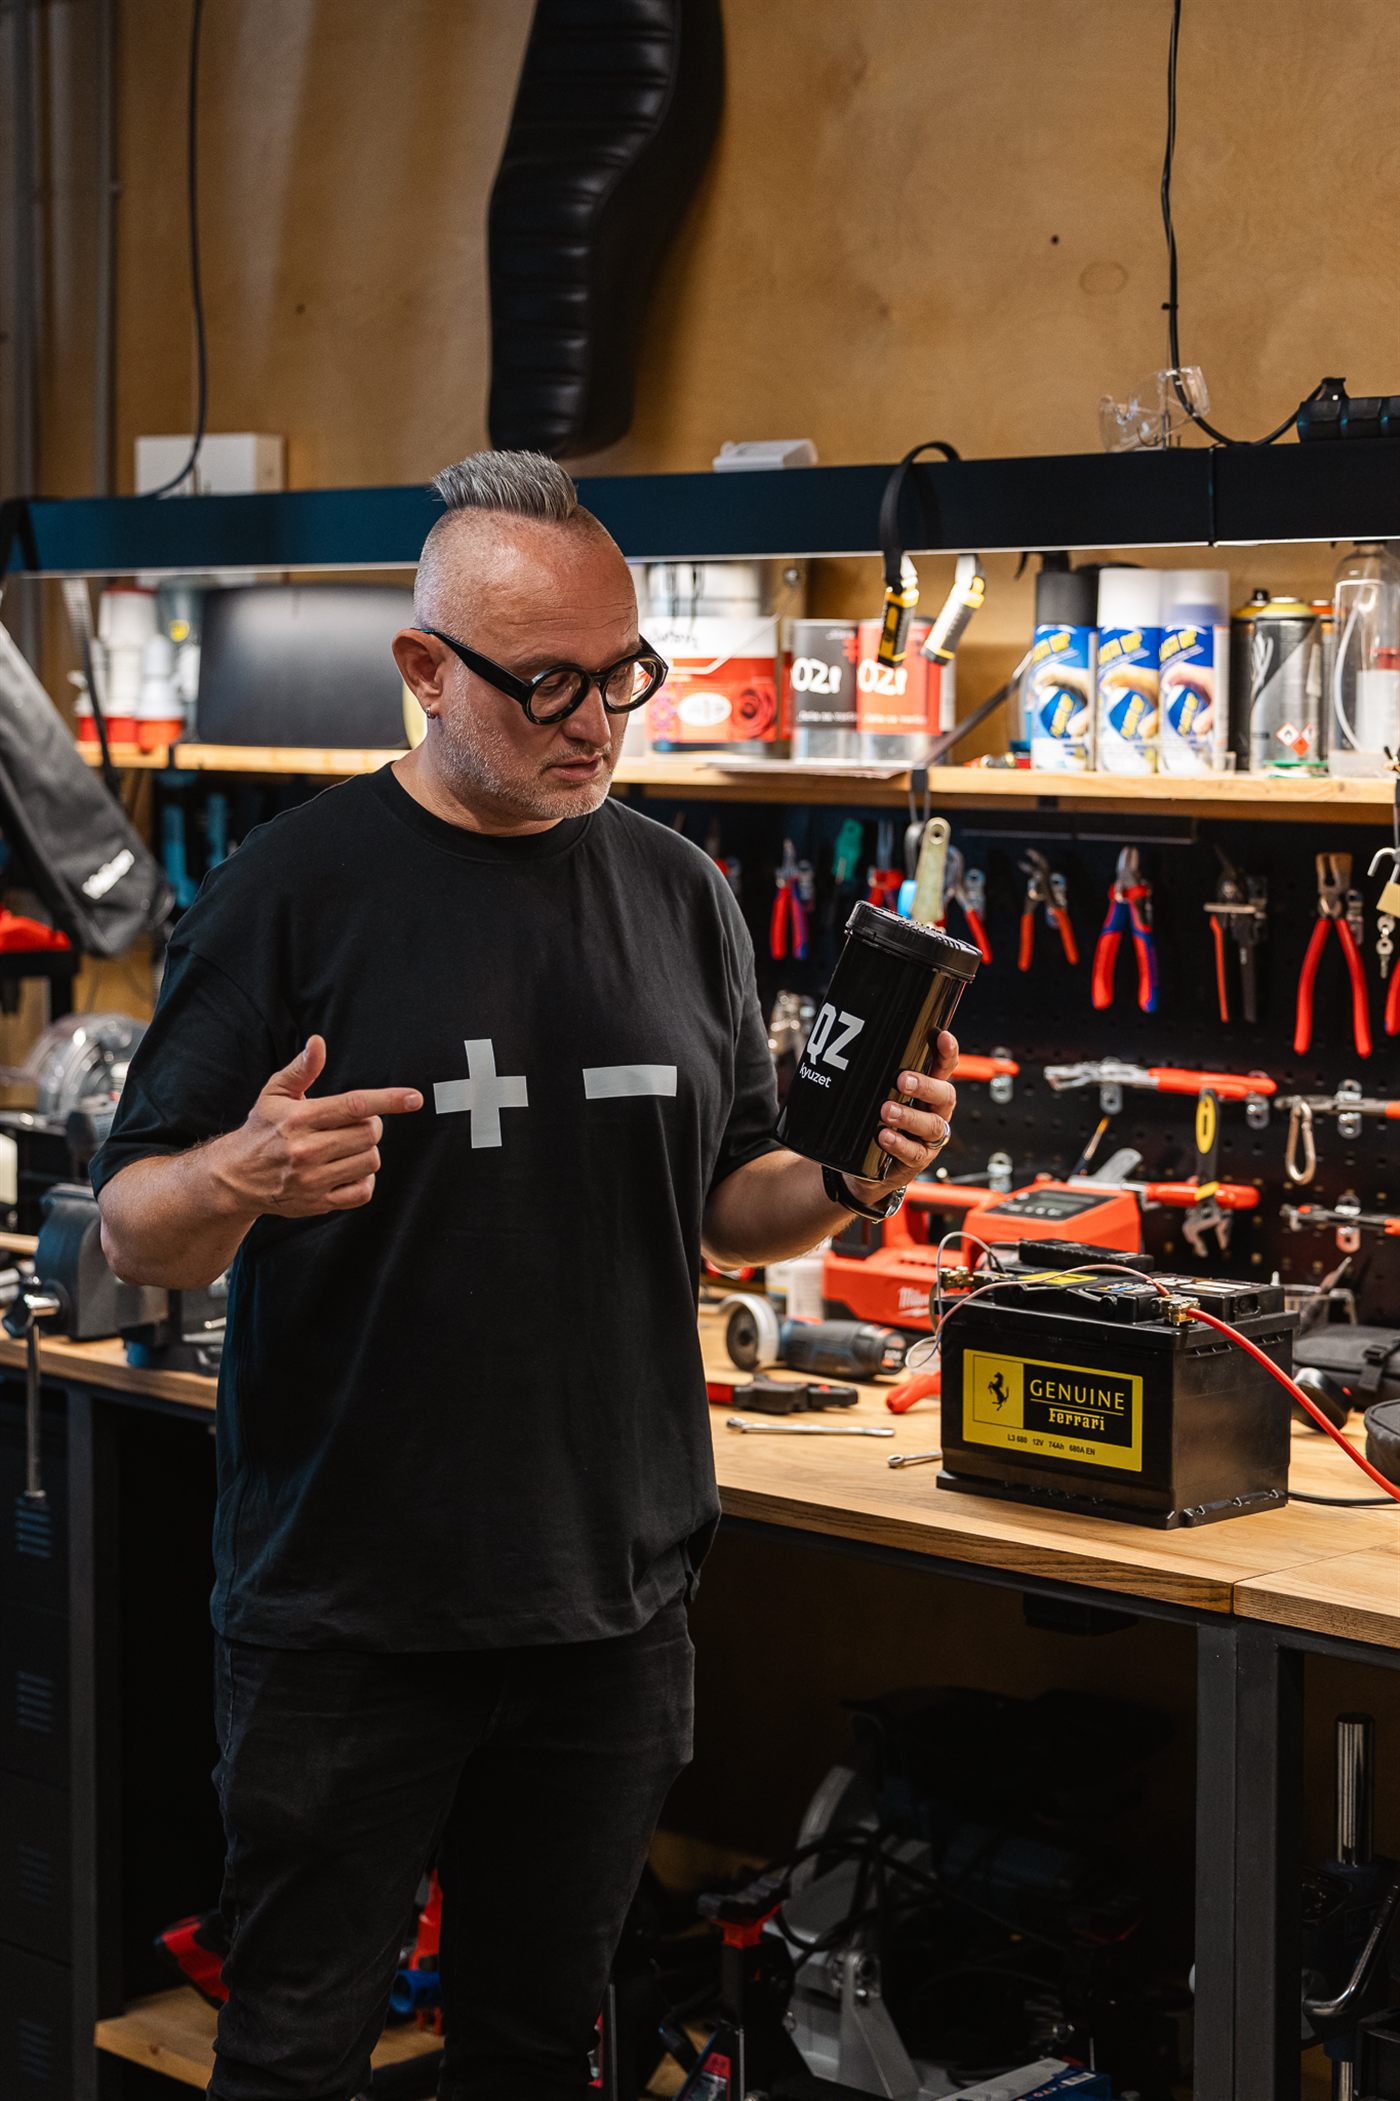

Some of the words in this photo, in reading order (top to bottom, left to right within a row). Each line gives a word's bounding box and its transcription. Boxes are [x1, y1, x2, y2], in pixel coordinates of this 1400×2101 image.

[807, 1002, 865, 1071] QZ
[800, 1062, 831, 1088] kyuzet
[1030, 1379, 1125, 1410] GENUINE
[1048, 1407, 1105, 1431] Ferrari
[1033, 1438, 1045, 1447] 12V
[1048, 1440, 1065, 1451] 74Ah
[1068, 1444, 1085, 1454] 680A
[1086, 1447, 1096, 1456] EN
